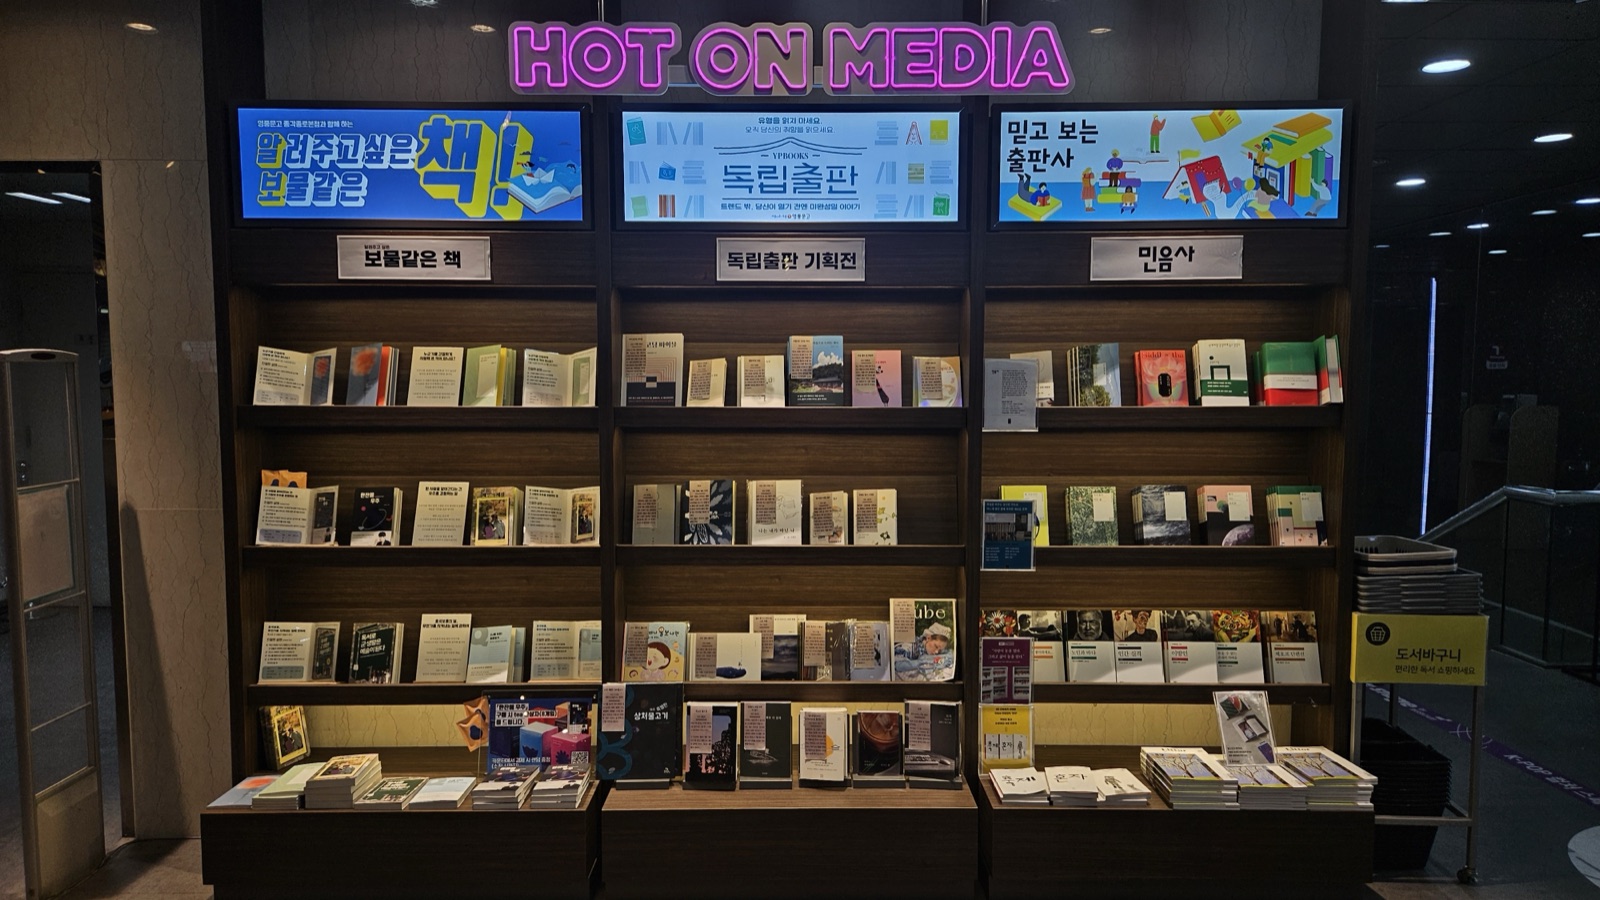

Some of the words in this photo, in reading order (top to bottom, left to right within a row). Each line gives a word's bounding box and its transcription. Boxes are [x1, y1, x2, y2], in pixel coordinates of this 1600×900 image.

[513, 26, 674, 88] HOT
[695, 26, 807, 88] ON
[829, 26, 1070, 88] MEDIA
[1008, 120, 1049, 144] 믿고
[1058, 119, 1099, 143] 보는
[772, 152, 809, 160] YPBOOKS
[1006, 148, 1075, 174] 출판사
[257, 171, 368, 207] 보물같은
[722, 163, 859, 195] 독립출판
[721, 203, 741, 211] 트렌드
[839, 203, 861, 211] 이야기
[364, 250, 437, 268] 보물같은
[443, 250, 461, 269] 책
[727, 251, 798, 271] 독립출판
[804, 251, 857, 270] 기획전
[1138, 246, 1195, 273] 민음사
[1396, 647, 1461, 663] 도서바구니
[1395, 665, 1418, 674] 편리한
[1437, 665, 1476, 675] 쇼핑하세요
[1054, 773, 1087, 783] 혼자
